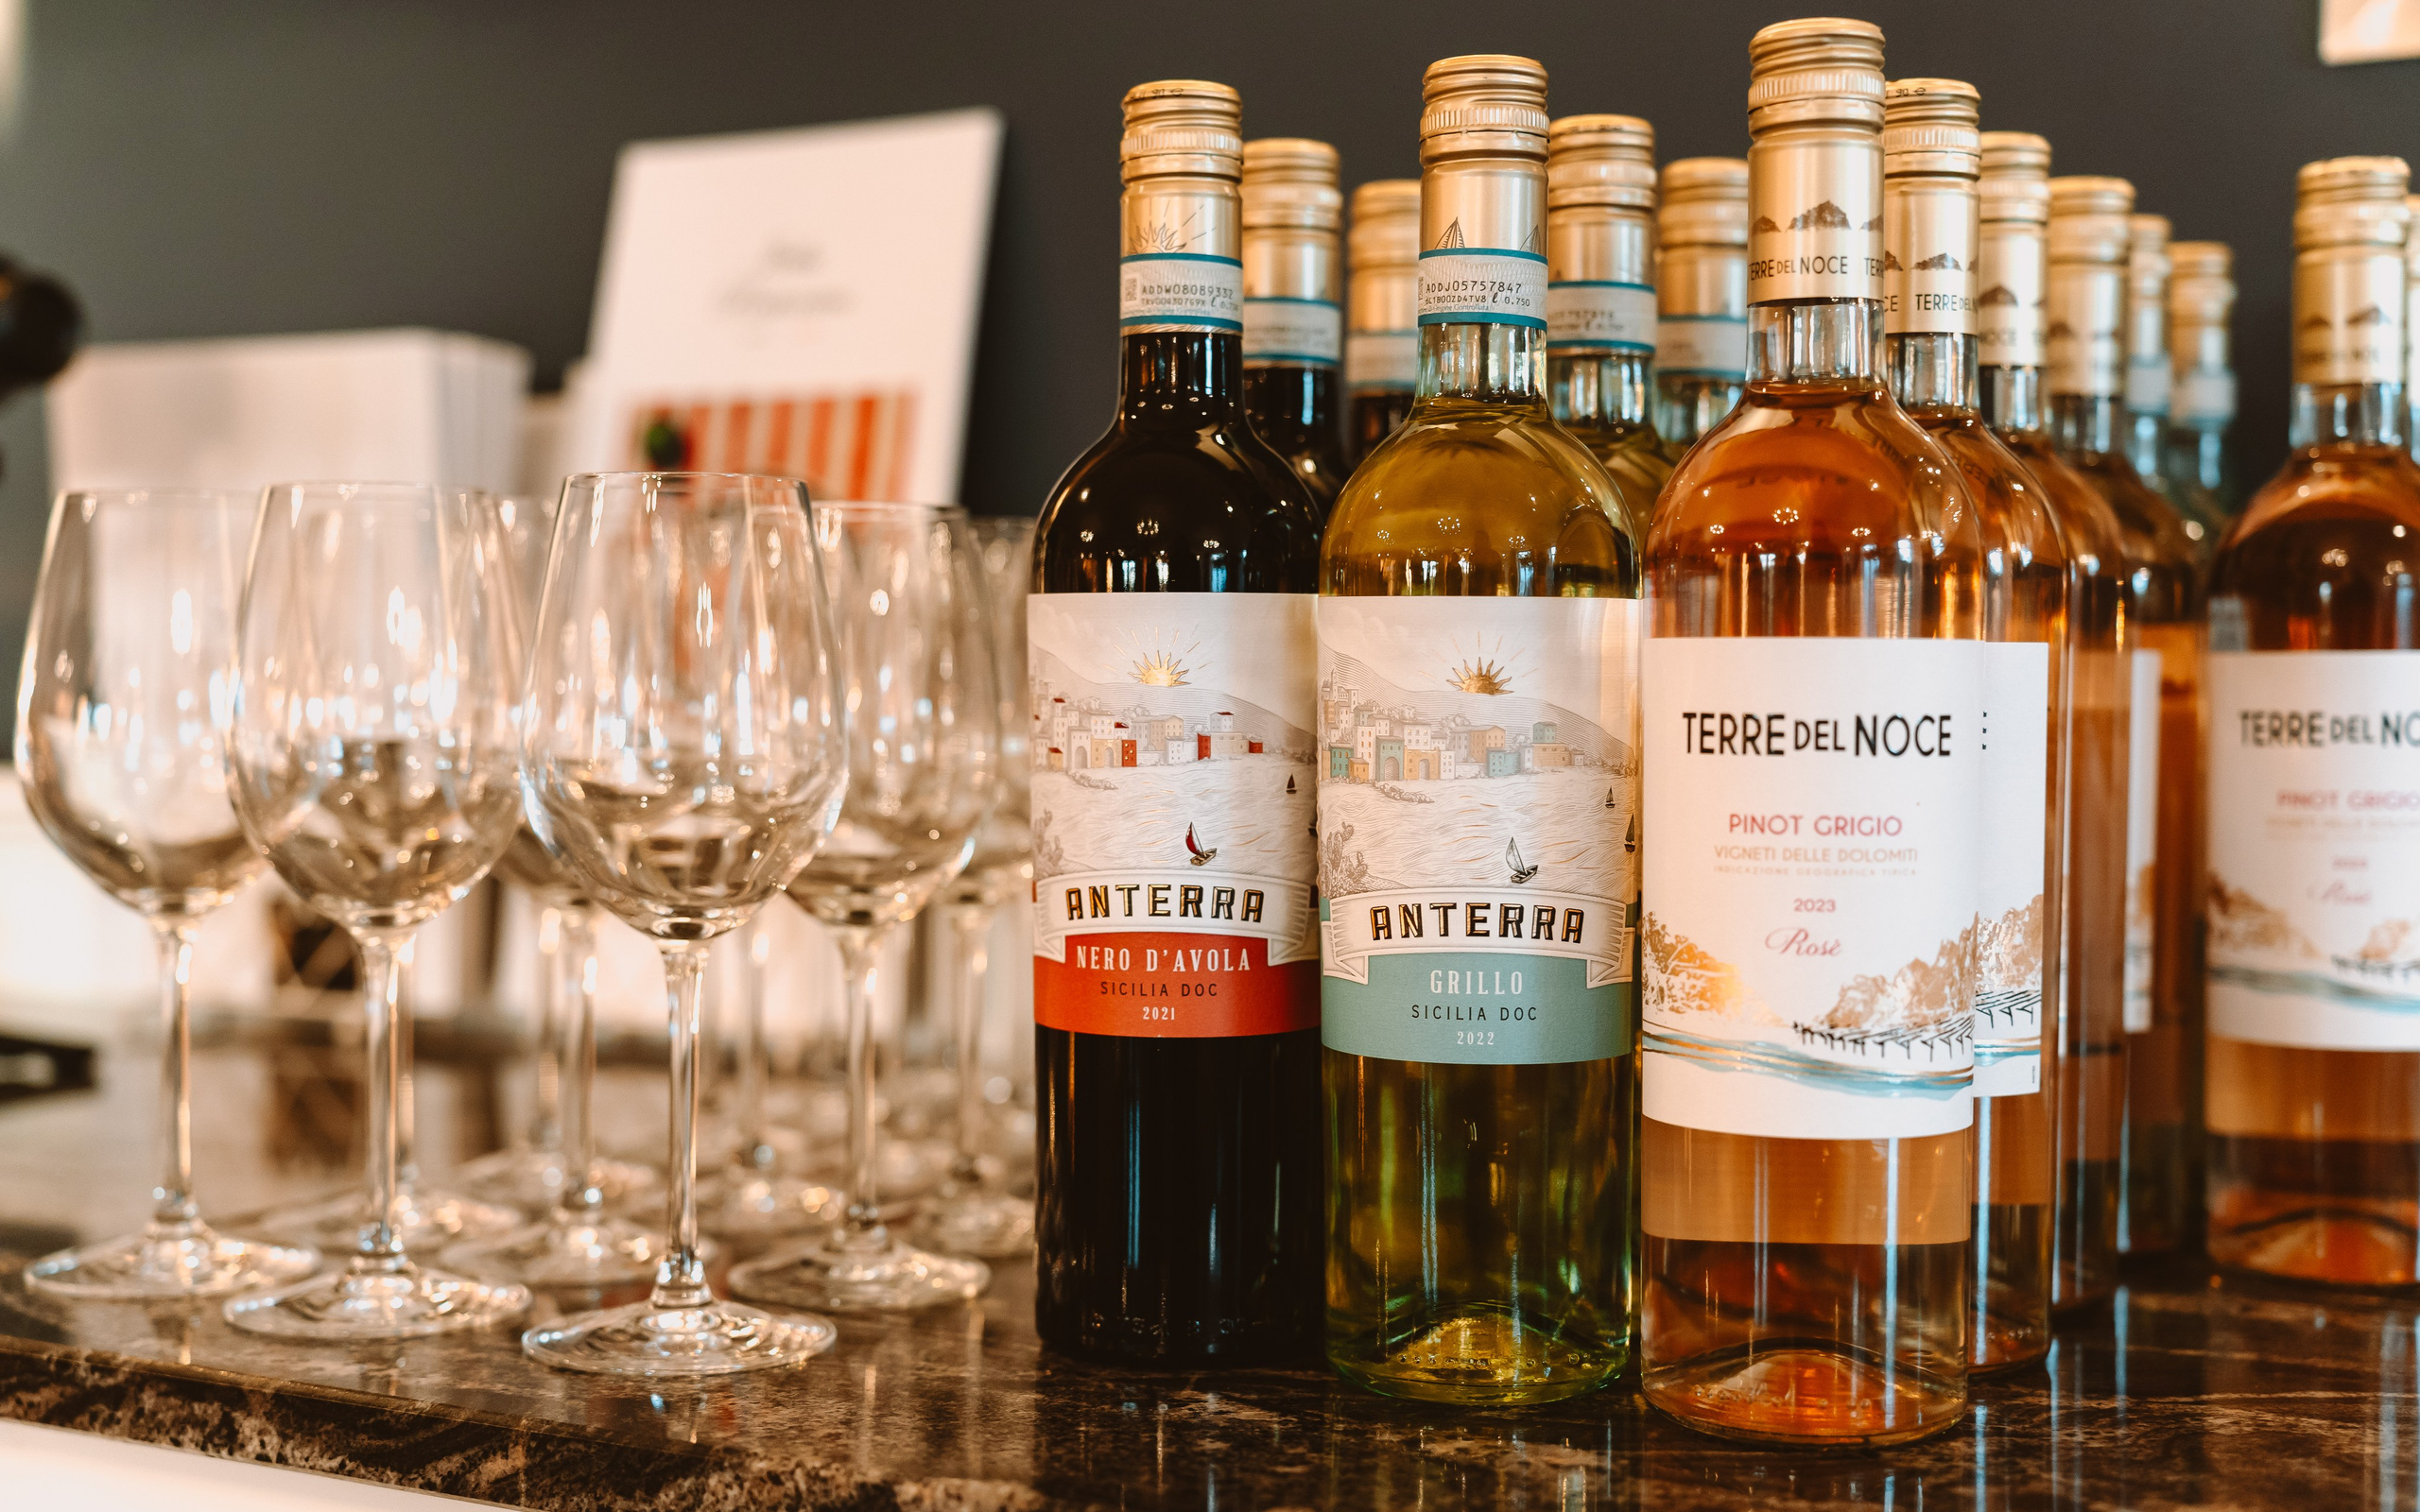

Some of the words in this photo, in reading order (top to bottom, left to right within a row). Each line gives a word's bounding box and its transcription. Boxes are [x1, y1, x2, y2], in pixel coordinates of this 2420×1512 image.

[1777, 260, 1796, 274] DEL
[1800, 255, 1848, 275] NOCE
[1915, 293, 1958, 311] TERRE
[1682, 712, 1786, 756] TERRE
[1794, 718, 1846, 753] DEL
[1854, 713, 1952, 757] NOCE
[2239, 710, 2325, 748] TERRE
[2329, 714, 2374, 745] DEL
[2380, 712, 2420, 748] NO
[1728, 814, 1804, 836] PINOT
[1813, 815, 1903, 837] GRIGIO
[1713, 845, 1776, 862] VIGNETI
[1782, 846, 1831, 864] DELLE
[1838, 847, 1918, 864] DOLOMITI
[1064, 884, 1265, 923] ANTERRA
[1793, 898, 1837, 913] 2023
[1370, 902, 1585, 944] ANTERRA
[1076, 945, 1131, 971] NERO
[1100, 981, 1169, 997] SICILIA
[1181, 983, 1219, 997] DOC
[1429, 970, 1524, 995] GRILLO
[1142, 1006, 1176, 1021] 2021
[1411, 1005, 1487, 1022] SICILIA
[1500, 1006, 1538, 1022] DOC
[1457, 1031, 1495, 1046] 2022
